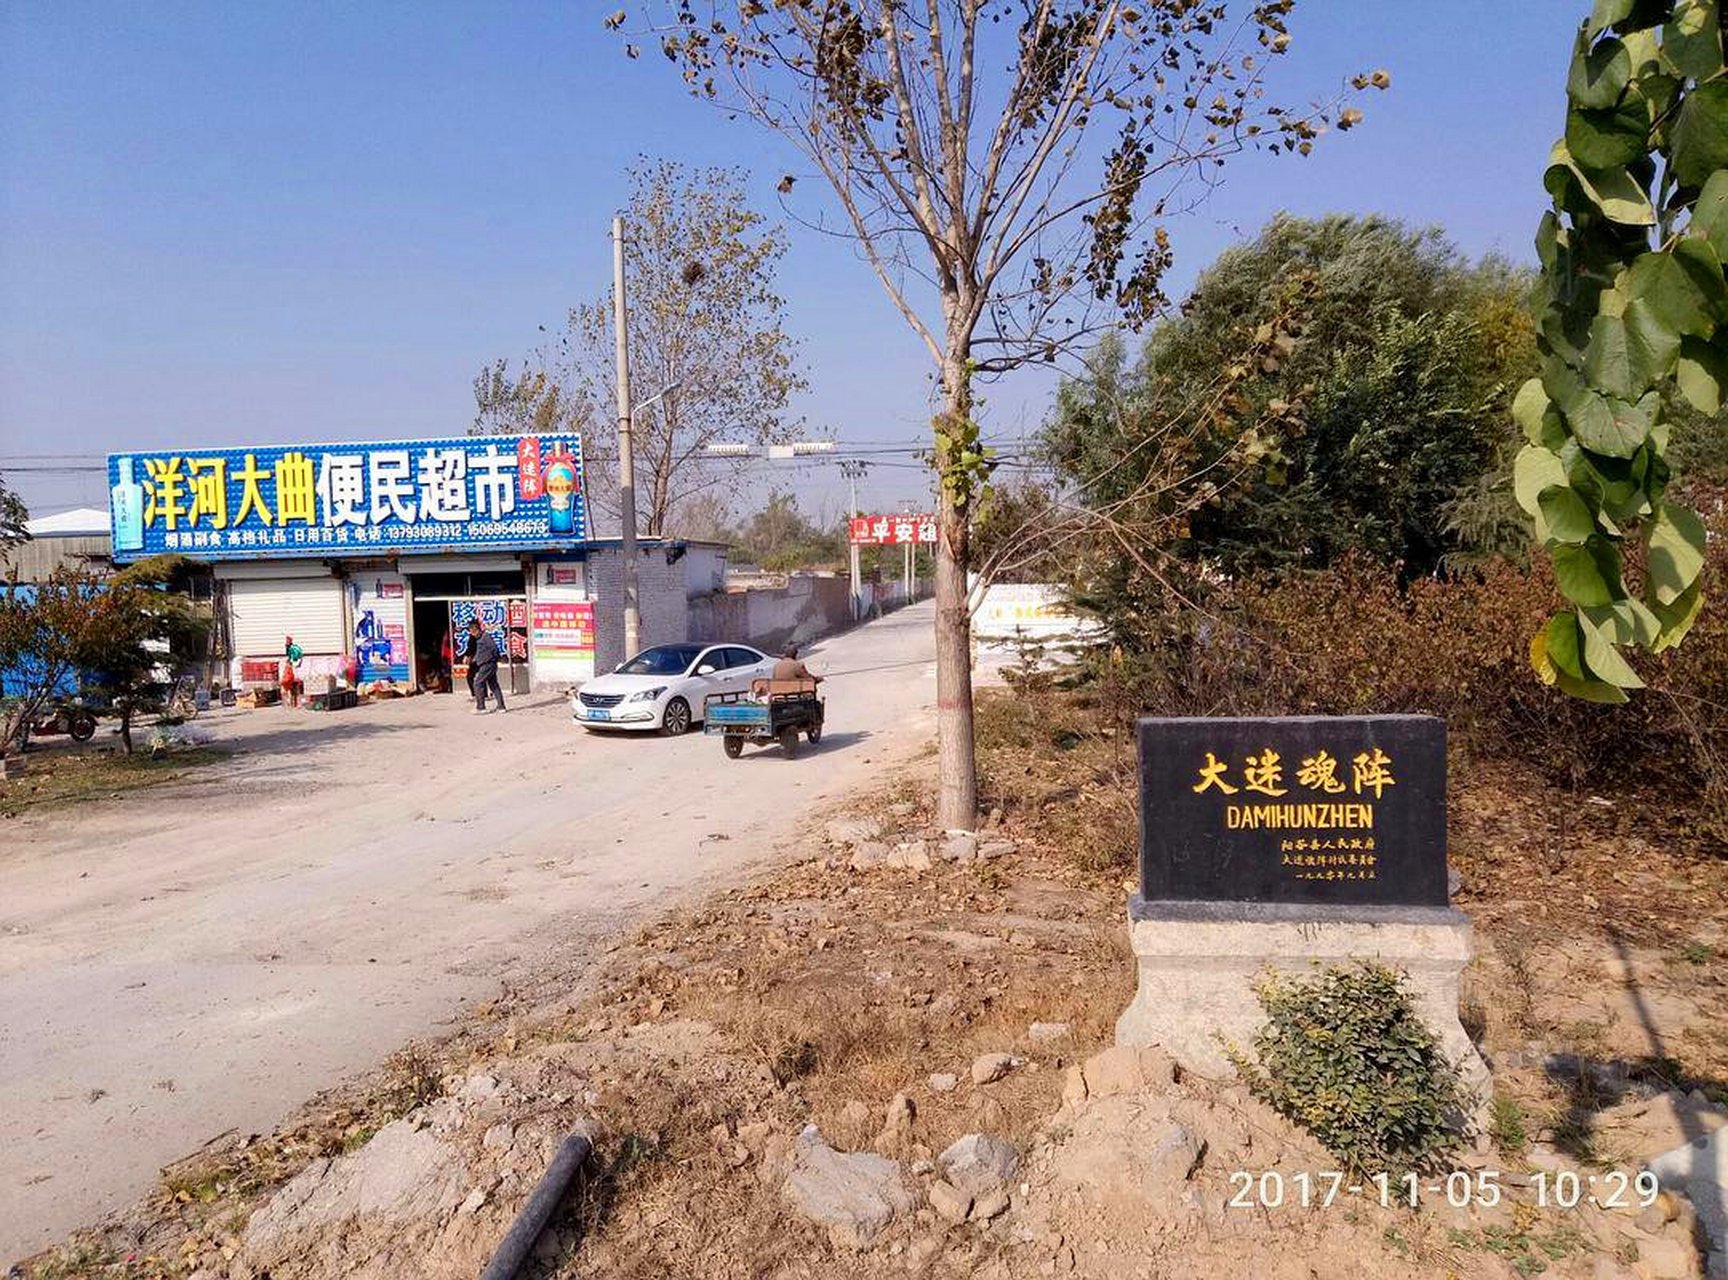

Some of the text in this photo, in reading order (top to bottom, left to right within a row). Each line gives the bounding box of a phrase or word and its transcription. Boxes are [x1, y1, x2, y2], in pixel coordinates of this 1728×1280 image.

[143, 443, 519, 530] 洋河大曲便民超市
[228, 529, 287, 546] 高档礼品
[294, 526, 350, 544] 日用百货
[452, 600, 507, 628] 移动
[1193, 748, 1397, 799] 大迷魂阵
[1227, 803, 1374, 830] DAMIHUNZHEN
